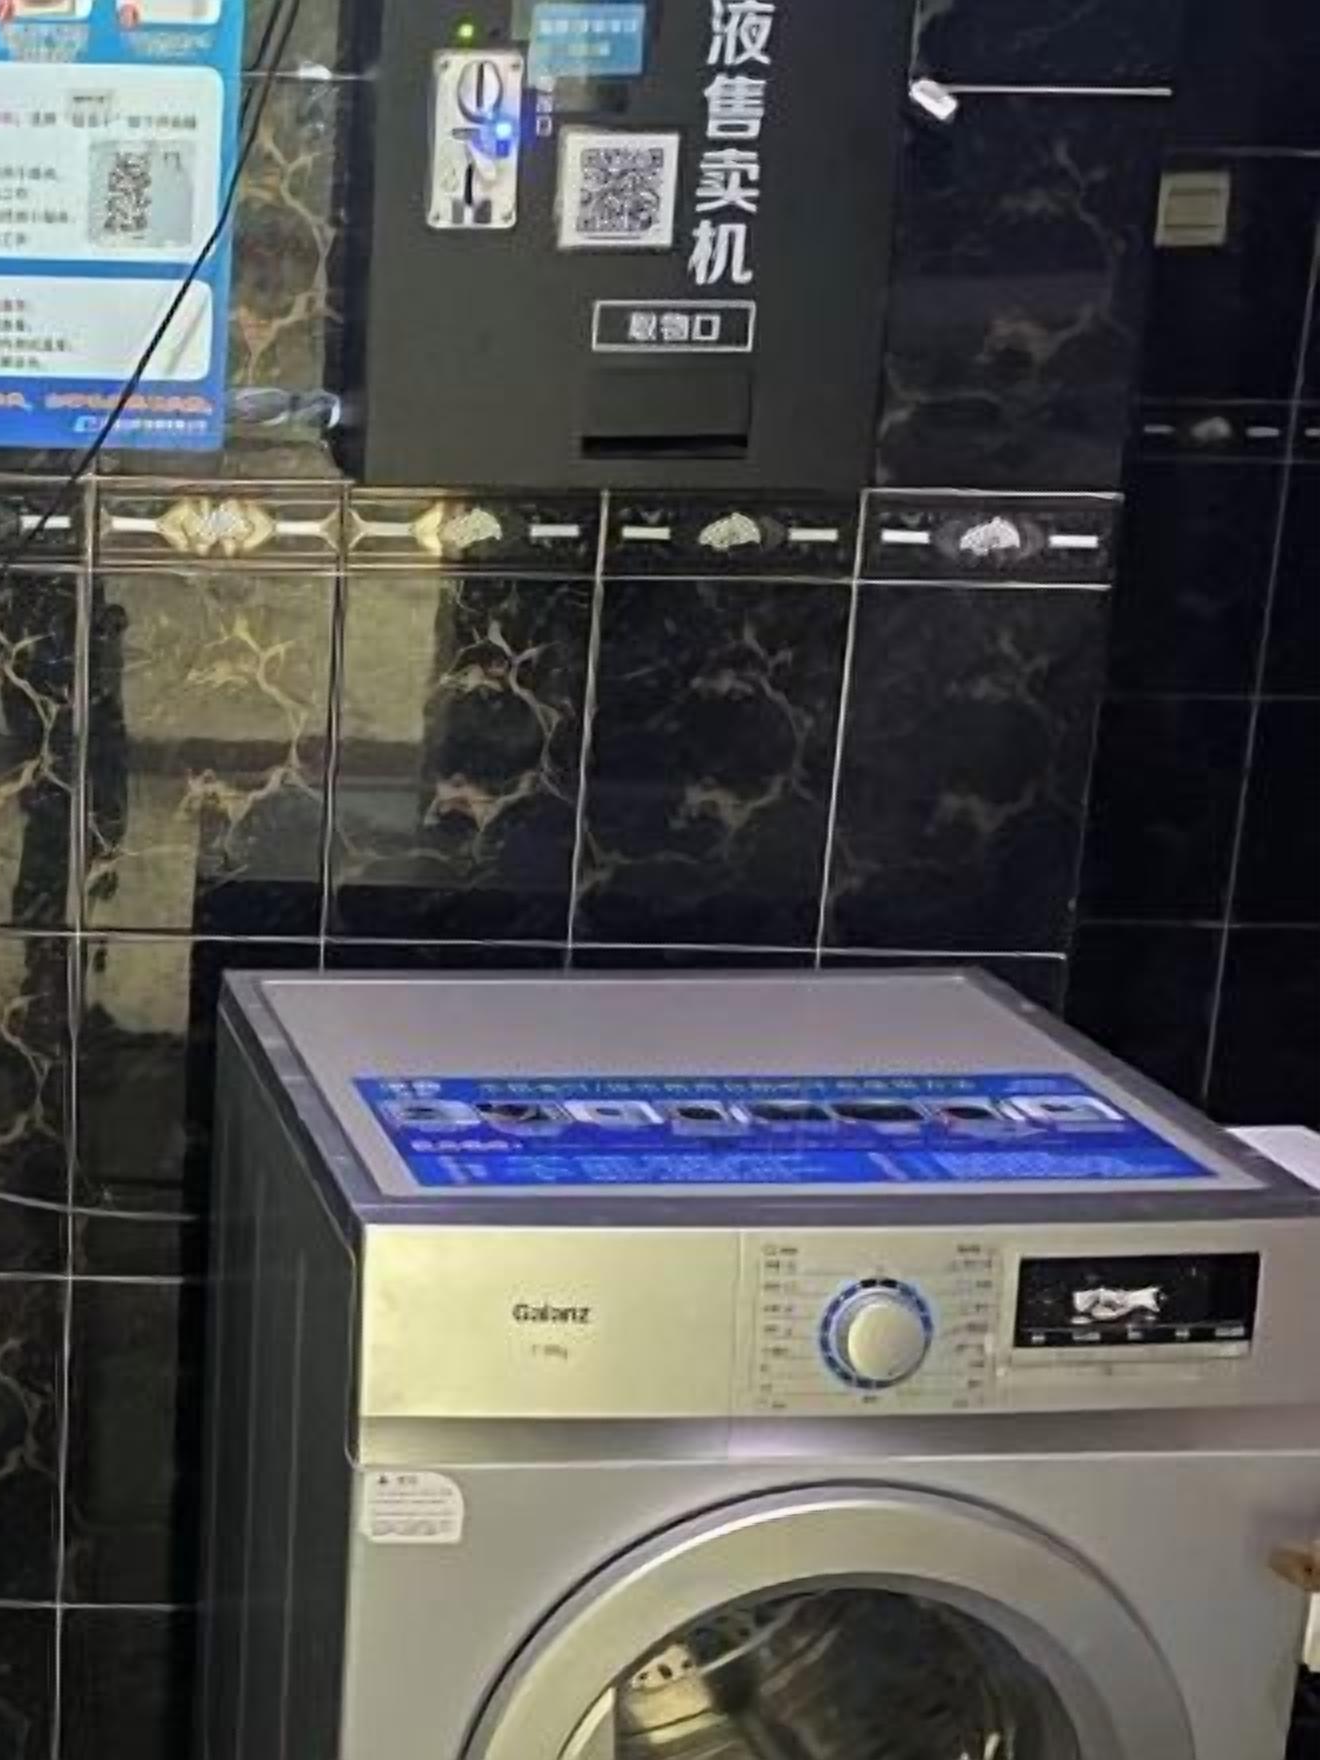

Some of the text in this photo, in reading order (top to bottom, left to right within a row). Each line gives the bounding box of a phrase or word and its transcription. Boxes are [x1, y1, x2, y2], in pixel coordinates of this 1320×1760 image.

[687, 0, 776, 285] 液售卖机
[512, 1302, 590, 1324] Galanz
